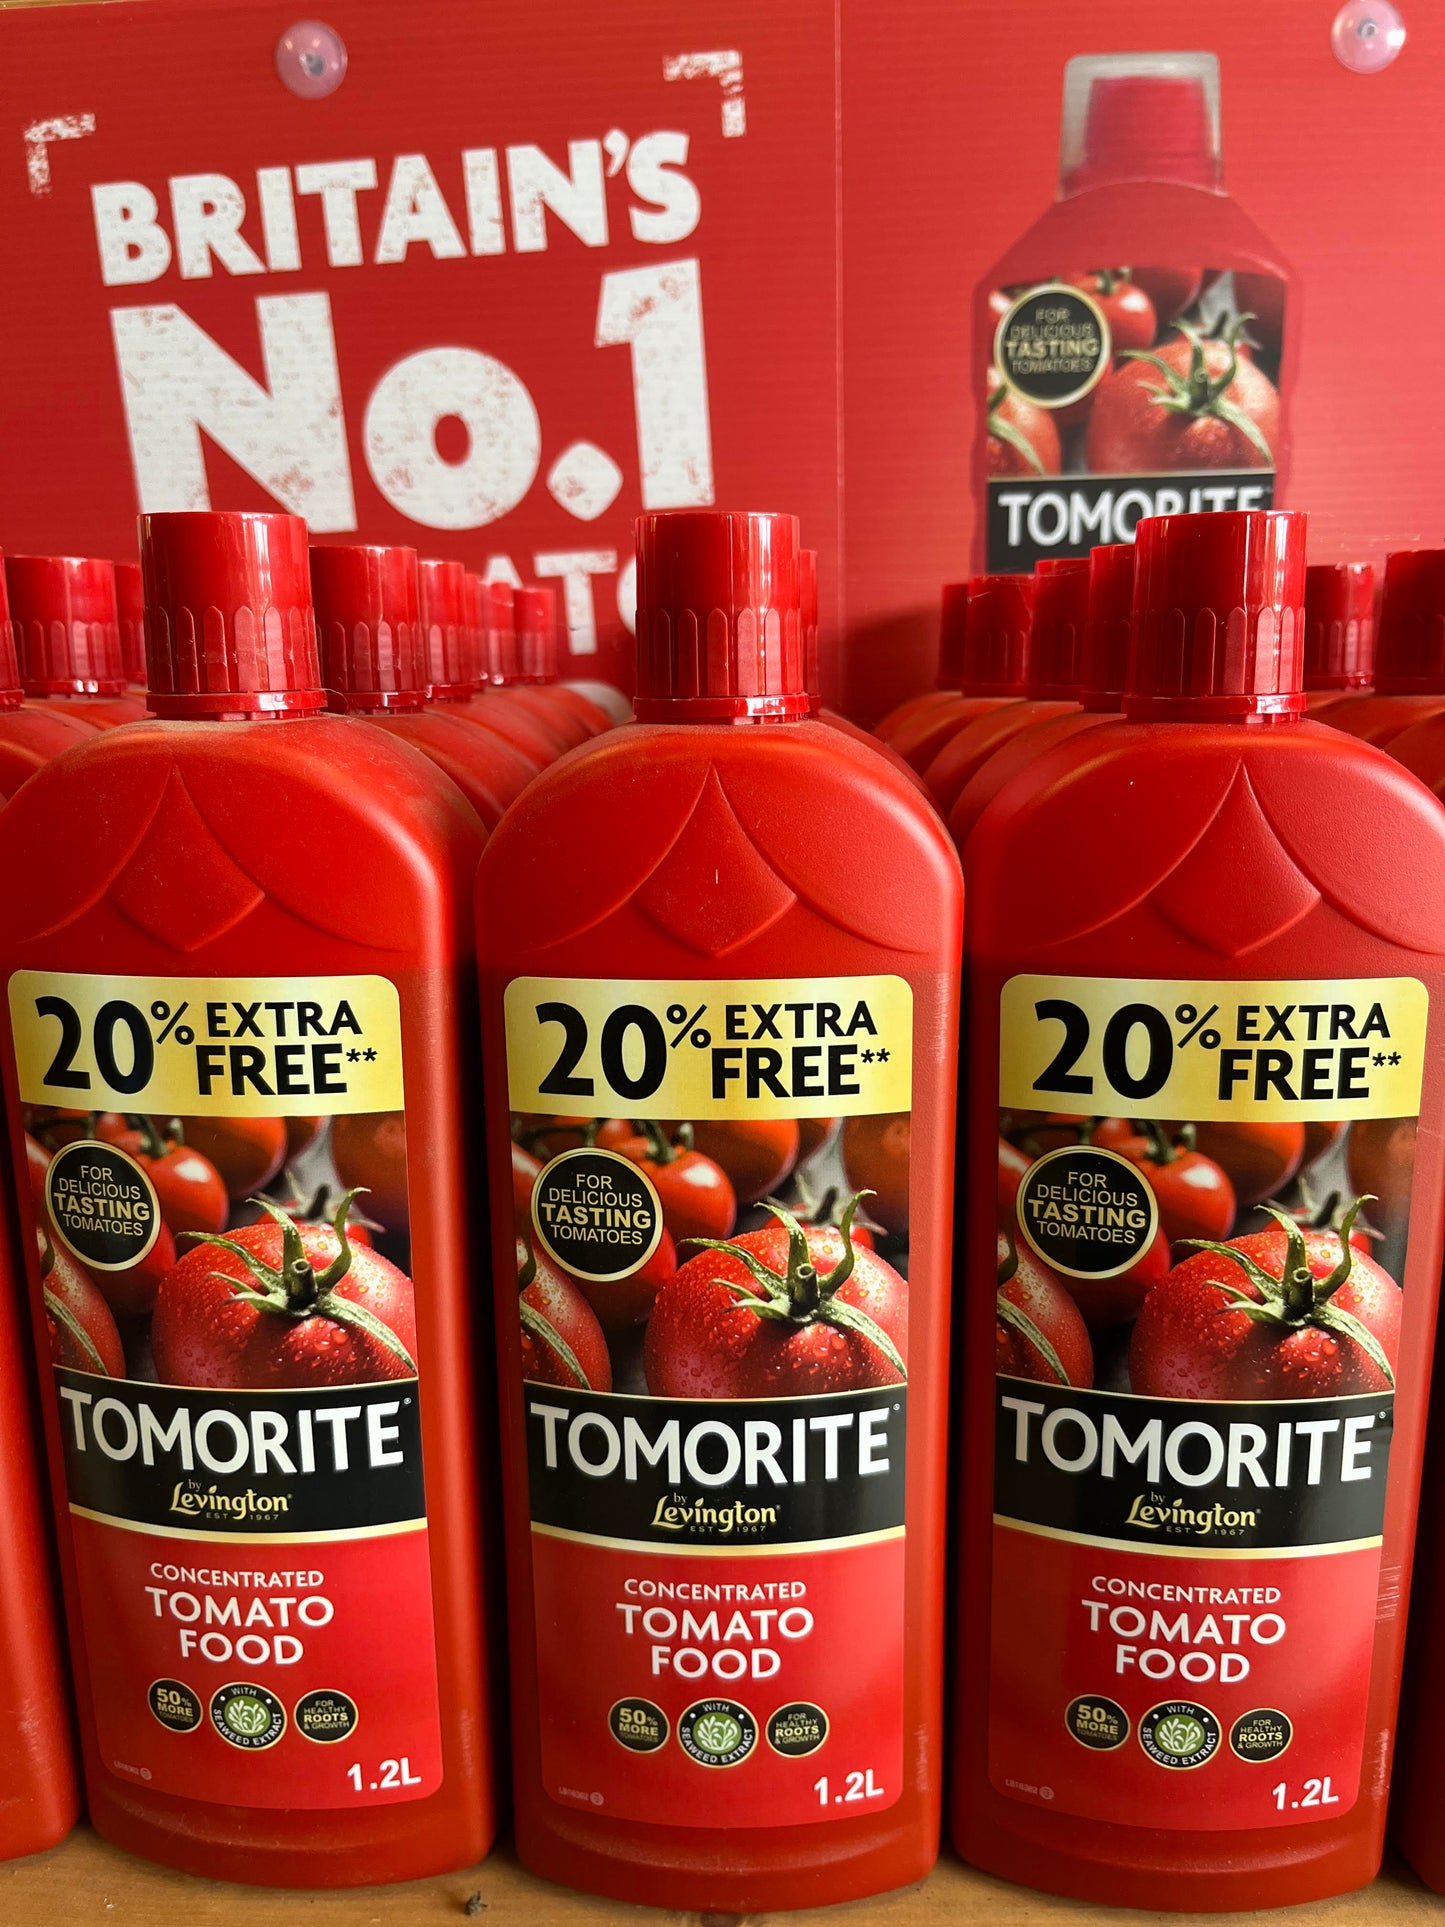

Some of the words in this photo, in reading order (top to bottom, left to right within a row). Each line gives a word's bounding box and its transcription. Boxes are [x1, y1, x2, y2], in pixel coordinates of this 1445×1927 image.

[90, 129, 701, 286] BRITAIN'S
[1036, 307, 1070, 324] FOR
[1006, 338, 1099, 359] TASTING
[1012, 358, 1093, 375] TOMATOES
[110, 258, 715, 533] No.1
[206, 1000, 363, 1037] EXTRA
[725, 1000, 878, 1040] EXTRA
[1236, 1002, 1391, 1042] EXTRA
[34, 995, 195, 1094] 20%
[535, 1001, 711, 1100] 20%
[1032, 998, 1221, 1099] 20%
[80, 1164, 113, 1182] FOR
[576, 1174, 612, 1190] FOR
[1068, 1171, 1106, 1188] FOR
[59, 1178, 141, 1200] DELICIOUS
[549, 1188, 642, 1208] DELICIOUS
[1037, 1184, 1138, 1207] DELICIOUS
[53, 1192, 150, 1221] TASTING
[541, 1203, 651, 1229] TASTING
[1028, 1199, 1146, 1228] TASTING
[62, 1214, 144, 1237] TOMATOES
[550, 1224, 643, 1246] TOMATOES
[1036, 1221, 1136, 1244] TOMATOES
[188, 1479, 202, 1492] by
[673, 1492, 687, 1506] by
[1151, 1491, 1165, 1506] by
[250, 1513, 279, 1521] 1967
[1214, 1528, 1245, 1536] 1967
[150, 1562, 324, 1588] CONCENTRATED
[624, 1578, 806, 1601] CONCENTRATED
[1092, 1576, 1281, 1604] CONCENTRATED
[144, 1585, 334, 1628] TOMATO
[616, 1603, 814, 1641] TOMATO
[1081, 1599, 1287, 1645] TOMATO
[179, 1629, 303, 1665] FOOD
[650, 1645, 782, 1680] FOOD
[1115, 1643, 1250, 1683] FOOD
[157, 1687, 192, 1708] 50%
[231, 1687, 257, 1697] WITH
[157, 1701, 193, 1717] MORE
[304, 1706, 346, 1714] HEALTHY
[315, 1700, 334, 1708] FOR
[702, 1703, 729, 1712] WITH
[1077, 1704, 1118, 1724] 50%
[1166, 1705, 1195, 1715] WITH
[213, 1709, 250, 1745] SEAWEED
[253, 1713, 281, 1745] EXTRACT
[304, 1713, 348, 1723] ROOTS
[311, 1721, 350, 1730] GROWTH
[619, 1707, 657, 1726] 50%
[776, 1718, 817, 1727] HEALTHY
[788, 1713, 806, 1721] FOR
[1076, 1718, 1118, 1735] MORE
[1253, 1719, 1271, 1727] FOR
[619, 1722, 659, 1737] MORE
[775, 1726, 819, 1737] ROOTS
[782, 1734, 820, 1744] GROWTH
[1239, 1731, 1283, 1742] ROOTS
[1240, 1725, 1282, 1733] HEALTHY
[682, 1726, 717, 1763] SEAWEED
[722, 1728, 753, 1763] EXTRACT
[1143, 1727, 1178, 1764] SEAWEED
[1182, 1731, 1216, 1765] EXTRACT
[1237, 1741, 1244, 1749] &
[1245, 1741, 1283, 1749] GROWTH
[347, 1757, 421, 1791] 1.2L
[814, 1769, 884, 1805] 1.2L
[1272, 1777, 1339, 1810] 1.2L
